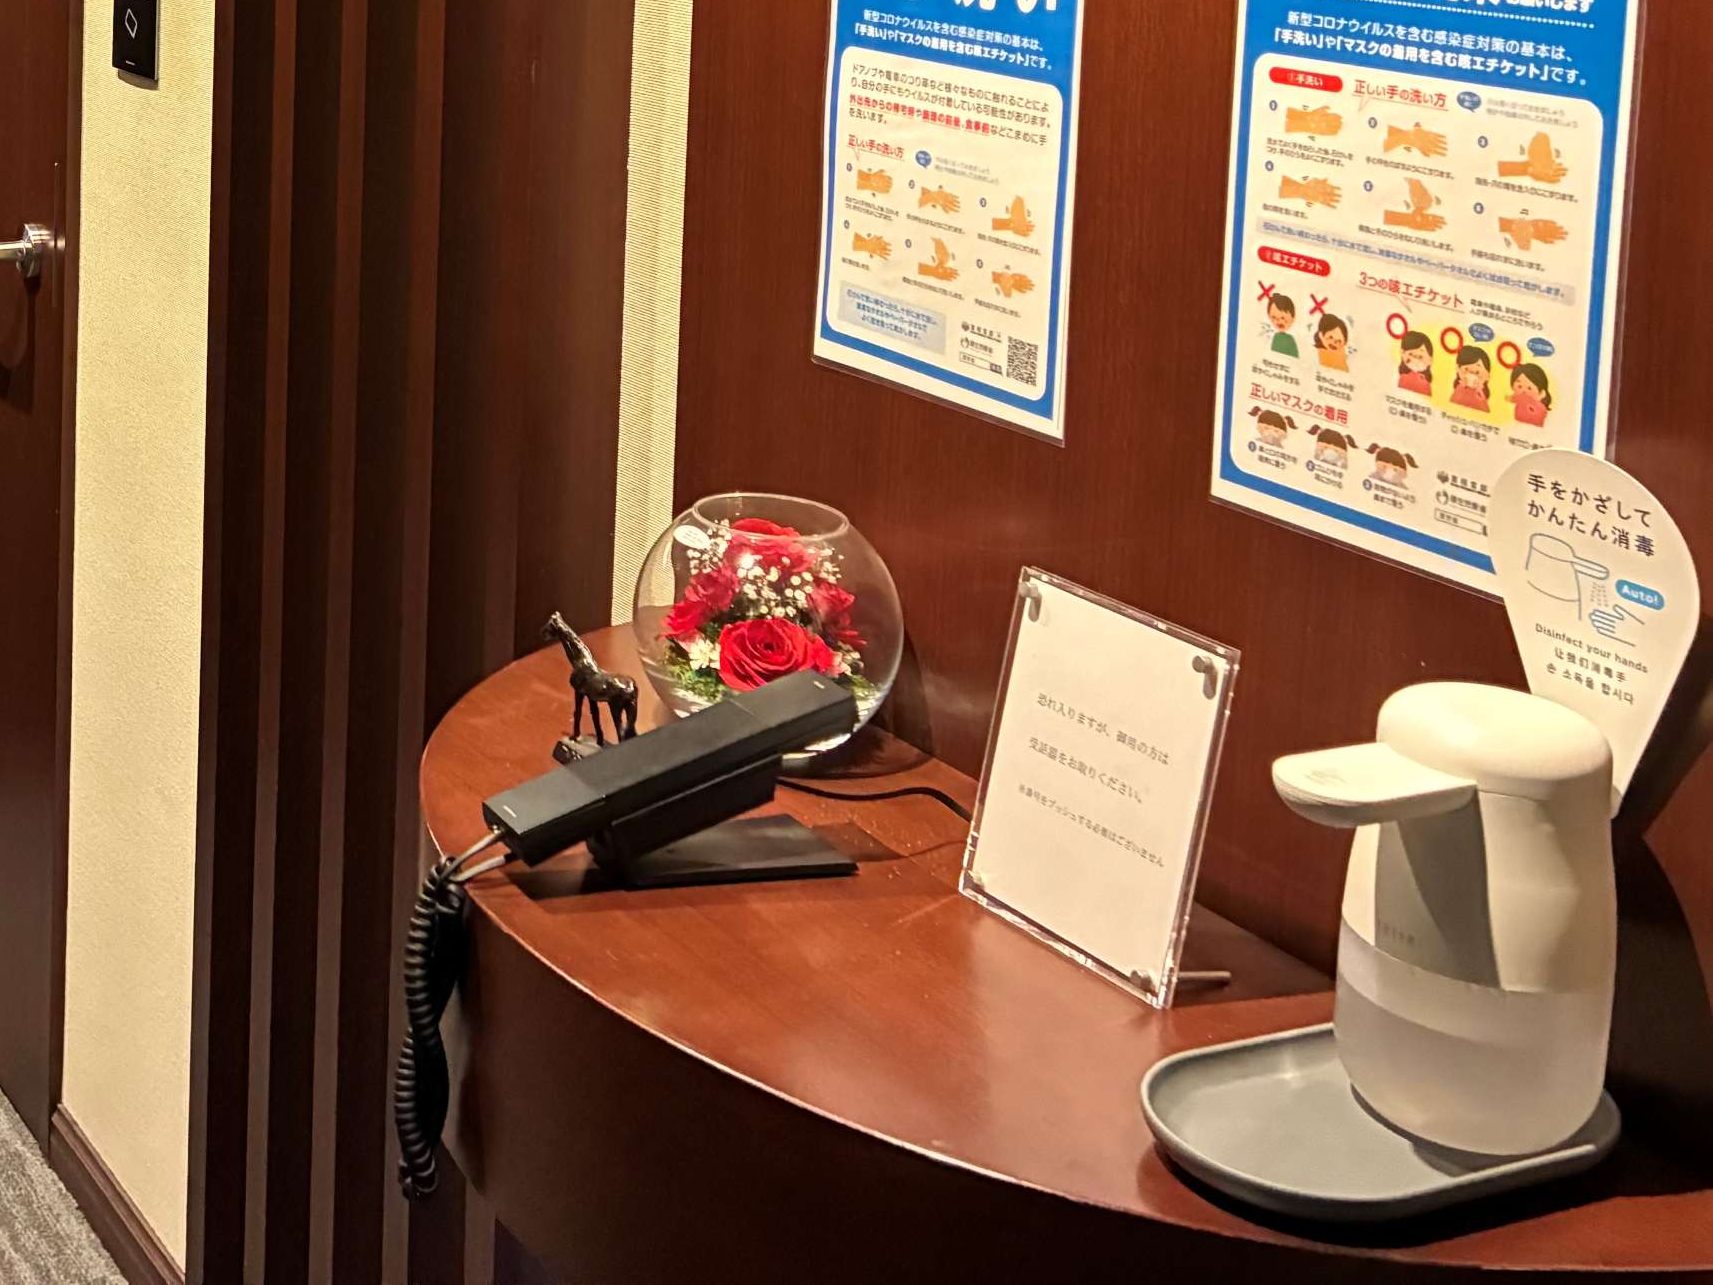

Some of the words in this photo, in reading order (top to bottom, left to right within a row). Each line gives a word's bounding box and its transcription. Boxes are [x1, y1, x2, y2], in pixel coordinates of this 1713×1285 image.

[1353, 78, 1448, 108] 正しい手の洗い方
[1526, 474, 1653, 528] 手をかざして
[1526, 500, 1656, 557] かんたん消毒
[1535, 622, 1583, 649] Disinfect
[1586, 644, 1612, 660] your
[1614, 653, 1649, 673] hands
